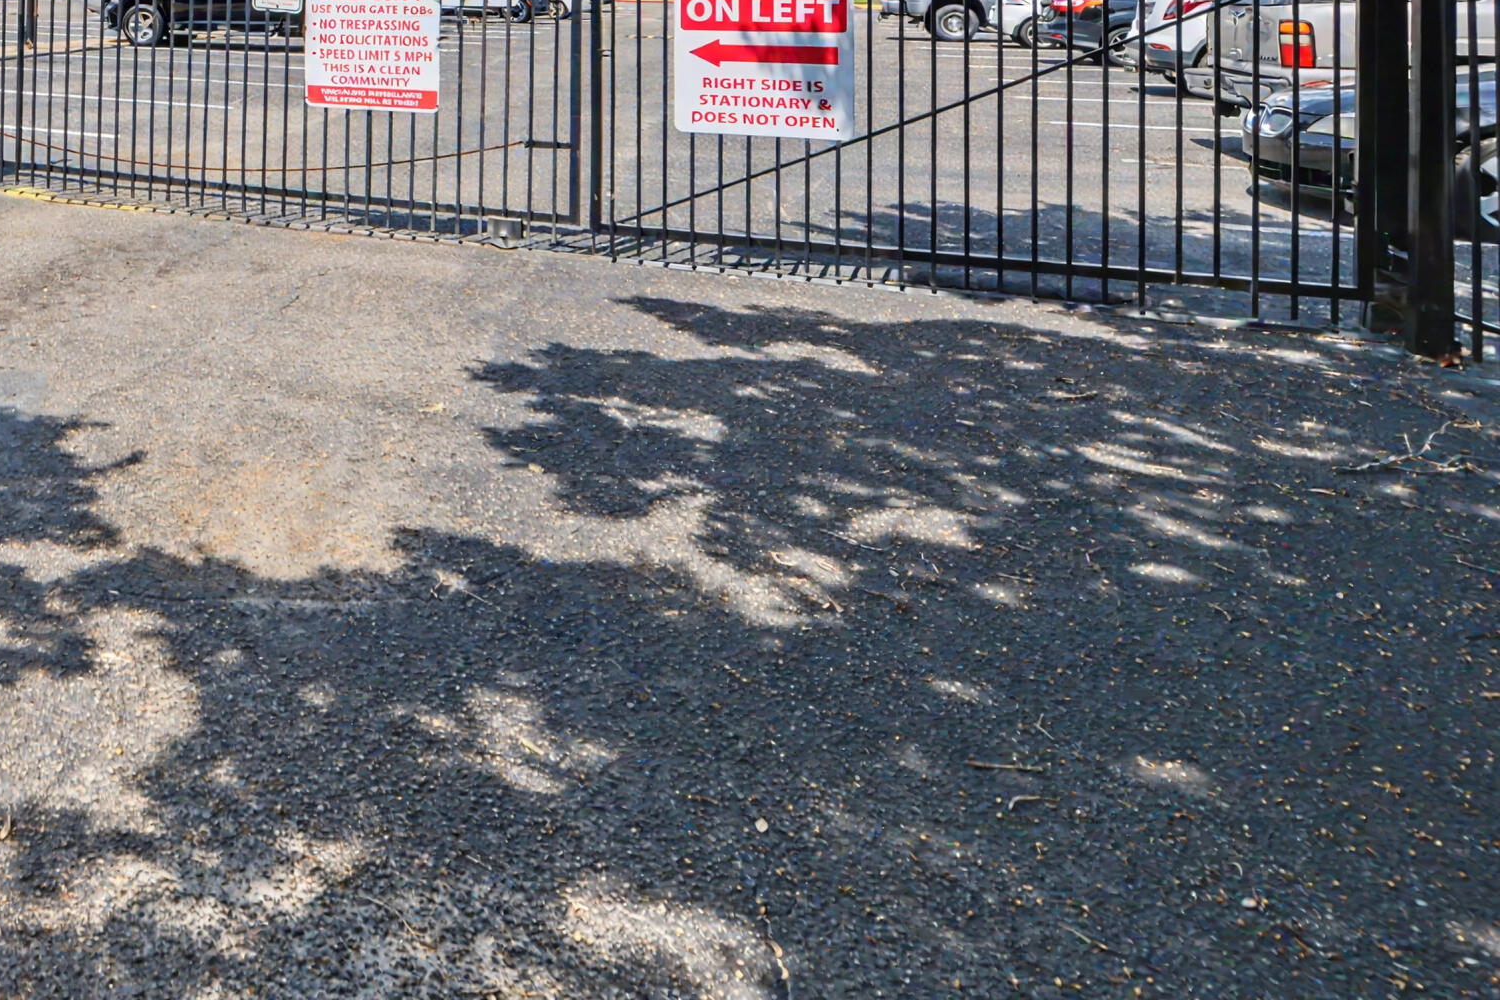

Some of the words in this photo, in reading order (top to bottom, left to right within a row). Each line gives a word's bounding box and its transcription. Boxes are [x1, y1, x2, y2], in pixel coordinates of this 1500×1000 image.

[311, 4, 332, 14] USE
[335, 4, 367, 14] YOUR
[369, 5, 399, 15] GATE
[319, 18, 337, 30] NO
[340, 19, 421, 32] TRESPASSING
[319, 34, 337, 44] NO
[340, 34, 429, 47] SOLICITATIONS
[319, 48, 355, 60] SPEED
[358, 49, 390, 61] LIMIT
[394, 51, 401, 61] 5
[405, 51, 433, 62] MPH
[323, 63, 350, 73] THIS
[354, 64, 365, 74] IS
[367, 64, 377, 74] A
[380, 65, 421, 76] CLEAN
[331, 75, 411, 87] COMMUNITY
[702, 77, 756, 90] RIGHT
[761, 79, 803, 92] SIDE
[806, 80, 824, 93] IS
[699, 94, 812, 110] STATIONARY
[818, 99, 832, 111] &
[691, 110, 738, 124] DOES
[742, 113, 780, 127] NOT
[784, 115, 836, 129] OPEN
